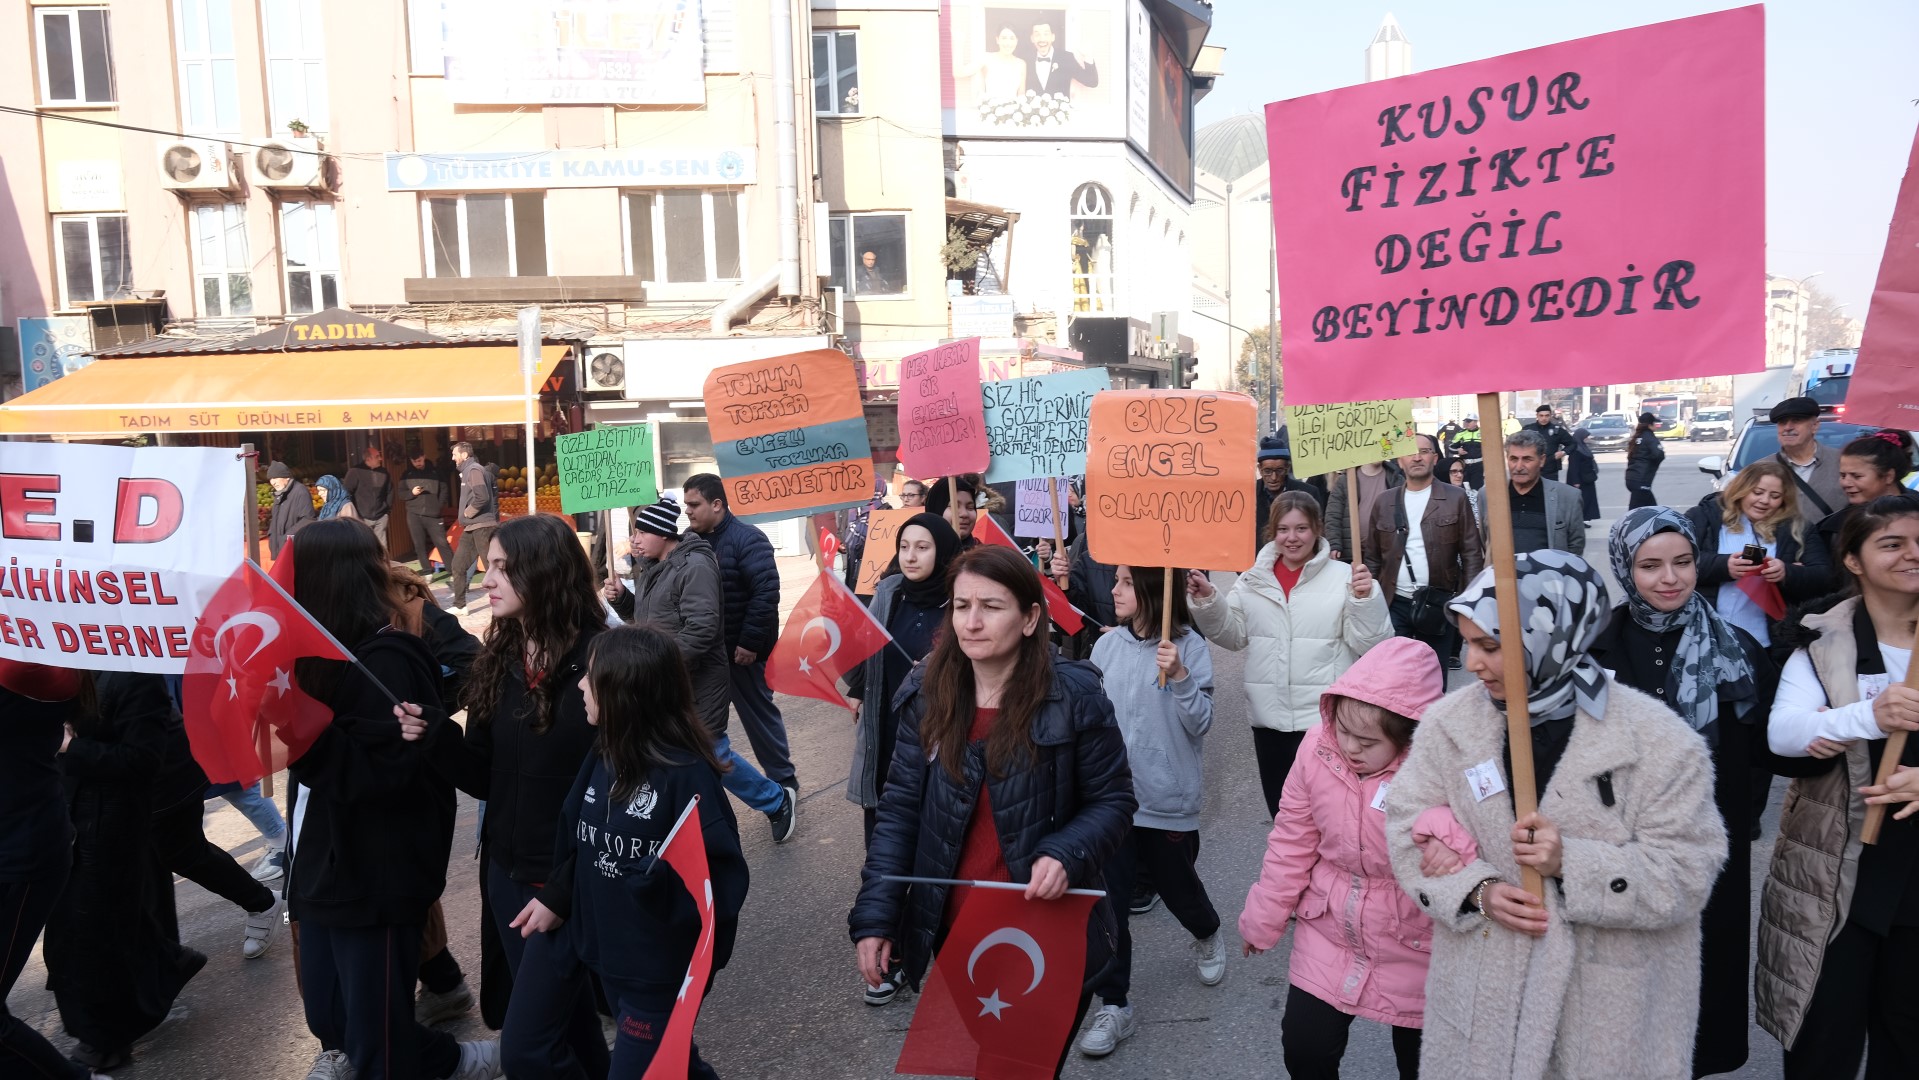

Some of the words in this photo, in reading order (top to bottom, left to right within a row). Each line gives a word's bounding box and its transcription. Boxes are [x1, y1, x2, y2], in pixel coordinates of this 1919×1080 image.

[1377, 71, 1590, 148] KUSUR
[436, 155, 552, 181] TÜRKİYE
[563, 157, 711, 178] KAMU-SEN
[1340, 133, 1617, 213] FİZİKTE
[1374, 210, 1563, 276] DEĞİL
[1312, 260, 1700, 344] BEYİNDEDİR
[293, 322, 376, 342] TADIM
[716, 363, 803, 398] TOHUM
[906, 355, 929, 379] HER
[920, 375, 939, 398] BİR
[982, 381, 1015, 409] SİZ
[1019, 378, 1044, 406] HİÇ
[120, 414, 171, 428] TADIM
[189, 411, 220, 427] SÜT
[237, 409, 322, 426] ÜRÜNLERİ
[342, 411, 352, 423] &
[370, 408, 430, 423] MANAV
[722, 393, 809, 425] TOPRAĞA
[1124, 393, 1218, 435] BİZE
[1297, 412, 1326, 437] İLGİ
[1336, 404, 1398, 430] GÖRMEK
[561, 433, 594, 454] ÖZEL
[596, 426, 646, 450] EĞİTİM
[562, 449, 620, 472] OLMADAN
[766, 442, 849, 469] TOPLUMA
[564, 467, 603, 486] ÇAĞDAŞ
[607, 459, 651, 480] EĞİTİM
[734, 462, 866, 506] EMANETTİR
[1098, 489, 1245, 523] OLMAYIN
[604, 832, 662, 859] YORK
[593, 860, 623, 877] CULTUR
